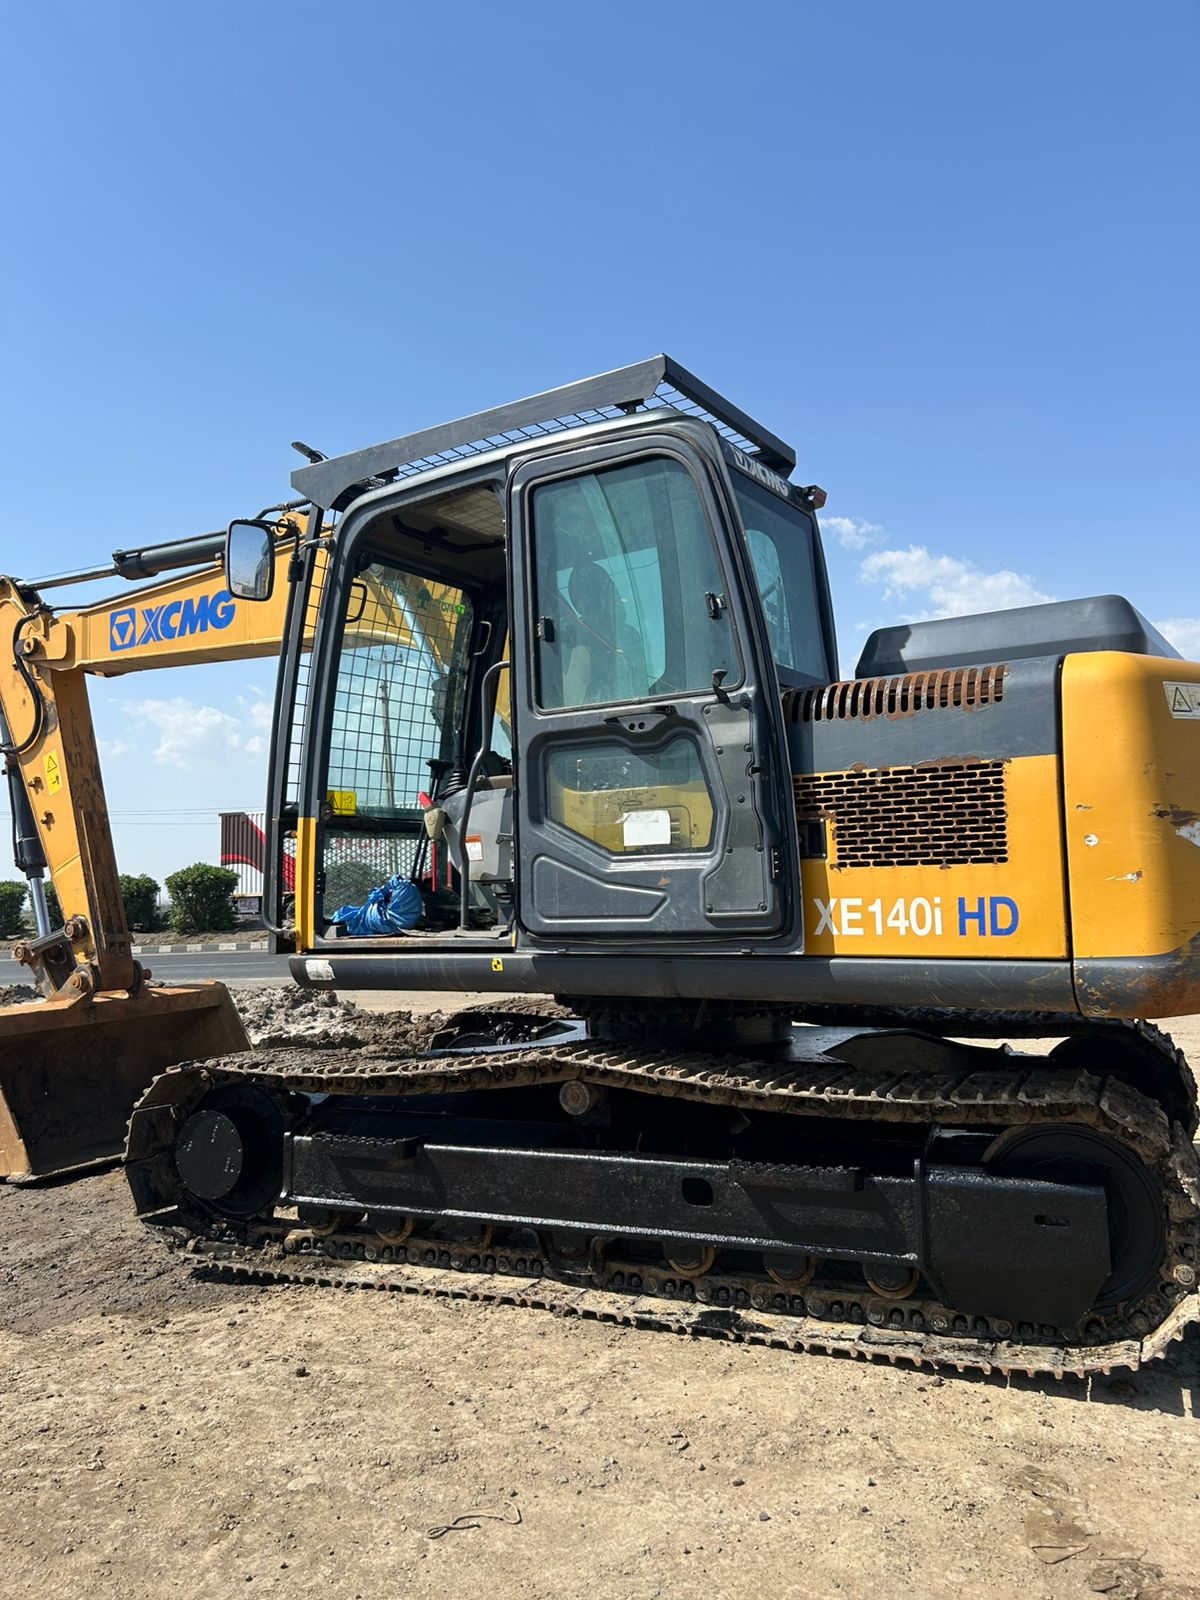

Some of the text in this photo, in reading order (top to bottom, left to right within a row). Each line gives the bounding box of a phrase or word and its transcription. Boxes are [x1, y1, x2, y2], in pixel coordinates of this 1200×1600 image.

[136, 589, 236, 647] XCMG
[813, 896, 1020, 937] XE140i HD
